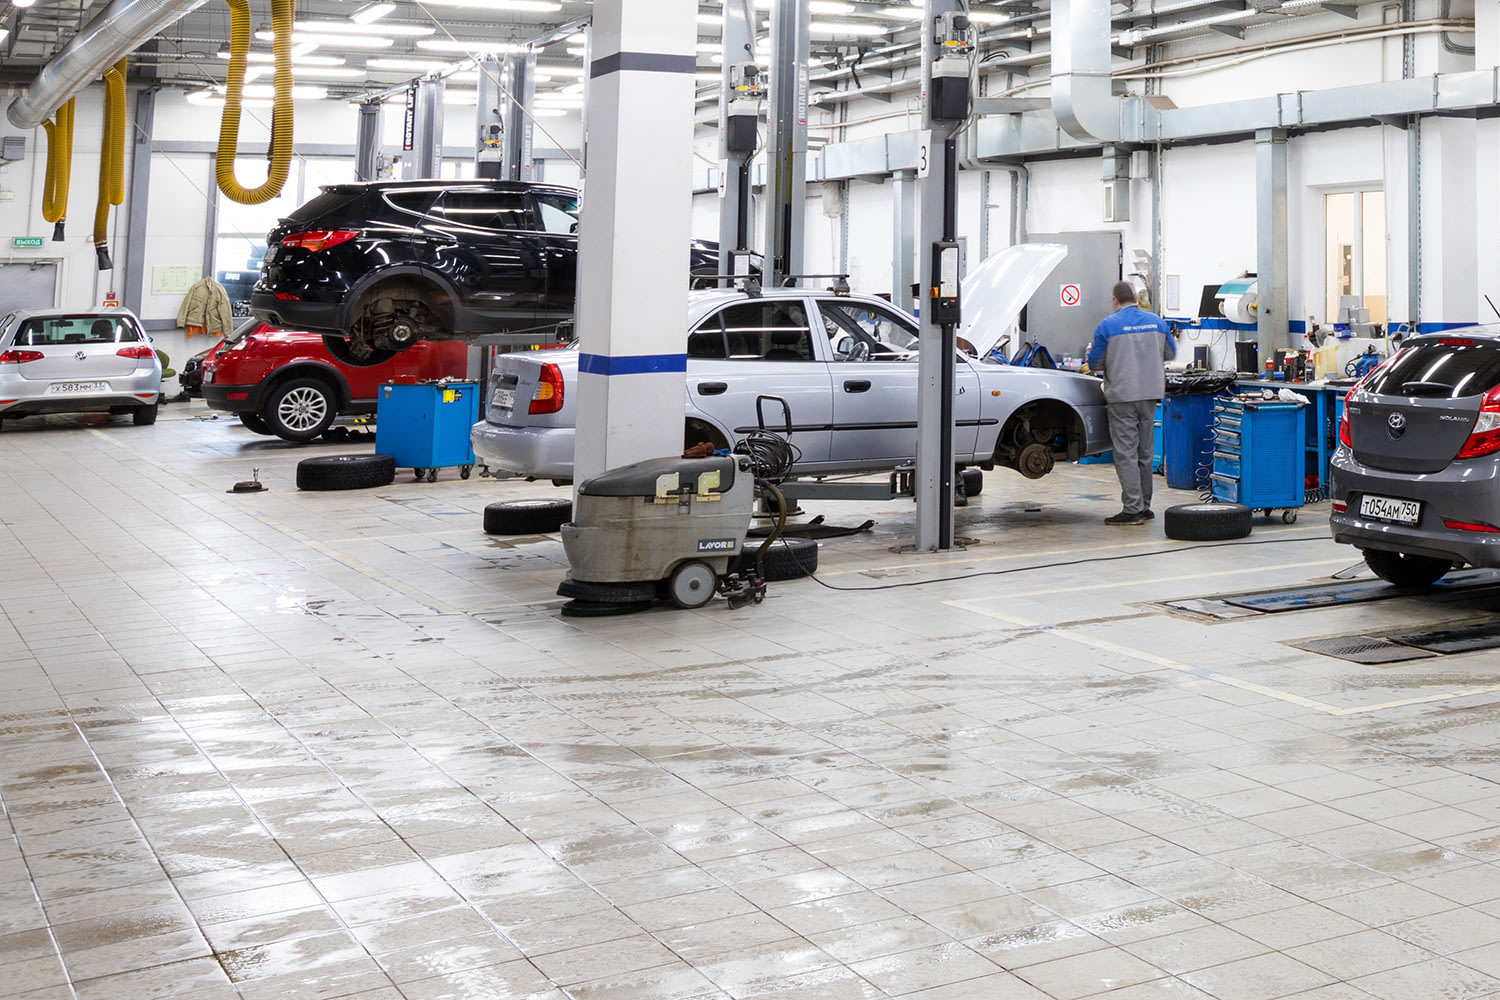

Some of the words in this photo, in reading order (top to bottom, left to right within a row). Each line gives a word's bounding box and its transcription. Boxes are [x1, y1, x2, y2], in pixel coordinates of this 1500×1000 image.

[798, 84, 807, 119] ROTARY
[405, 110, 414, 146] ROTARY
[920, 144, 928, 171] 3
[1401, 502, 1417, 516] 750
[699, 541, 727, 550] LAVOR
